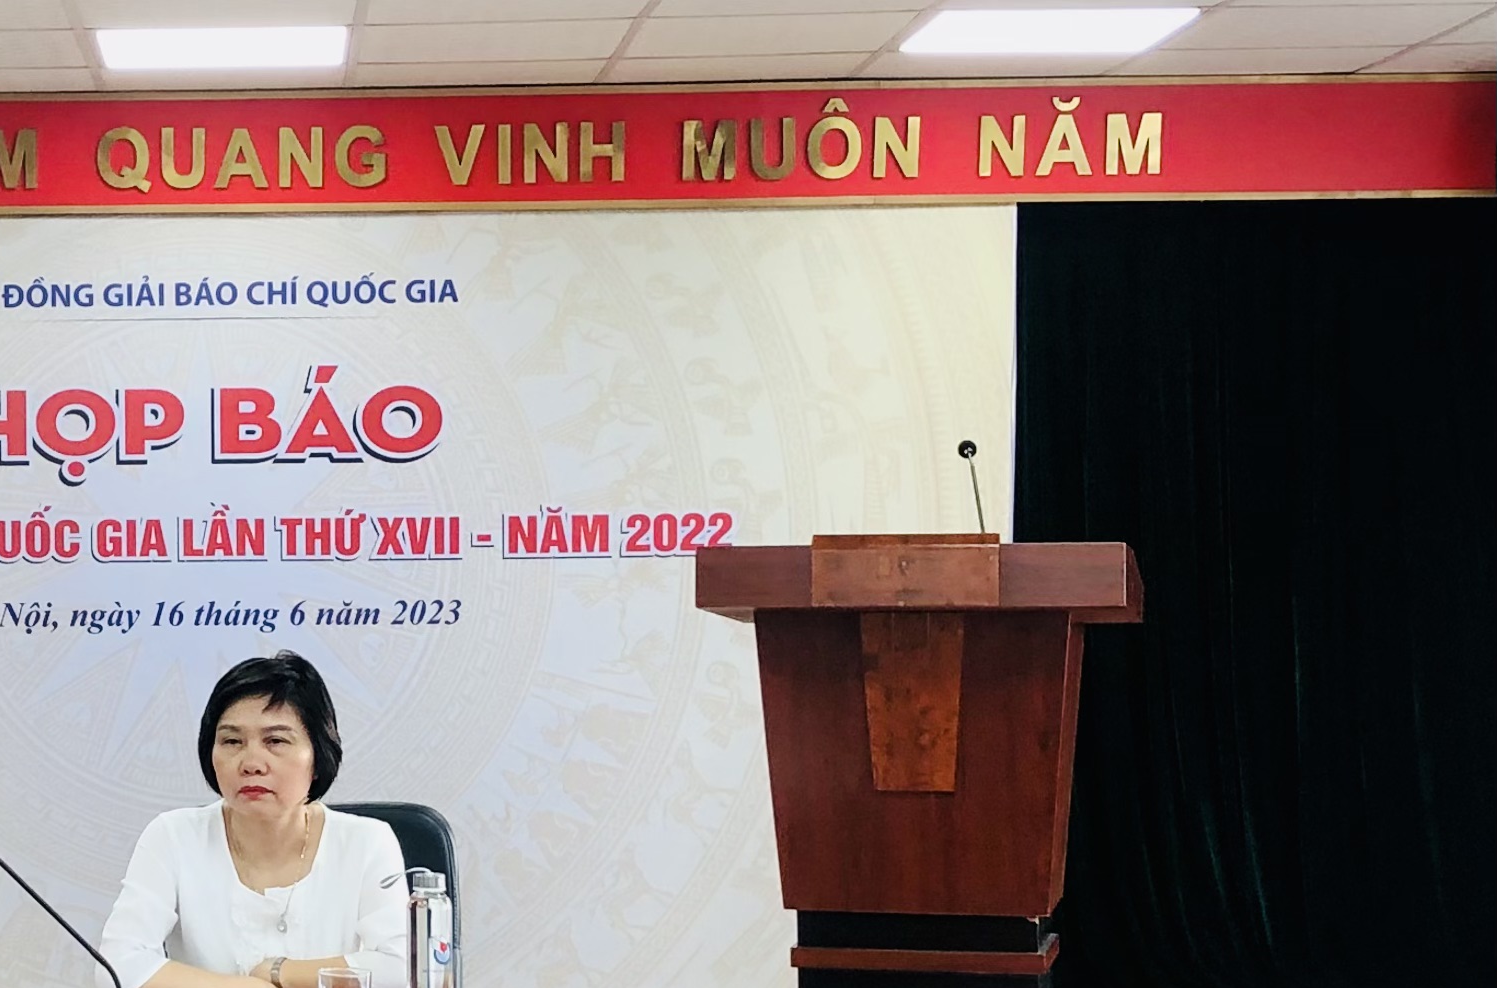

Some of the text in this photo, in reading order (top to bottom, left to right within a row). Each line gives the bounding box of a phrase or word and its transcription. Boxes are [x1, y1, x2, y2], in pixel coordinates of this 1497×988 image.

[96, 125, 388, 195] QUANG
[434, 119, 627, 187] VINH
[681, 97, 922, 183] MUÔN
[978, 96, 1164, 179] NĂM
[1, 276, 94, 308] ĐỒNG
[103, 275, 164, 307] GIẢI
[174, 277, 238, 307] BÁO
[246, 275, 299, 305] CHÍ
[306, 272, 397, 307] QUỐC
[405, 279, 459, 304] GIA
[213, 364, 444, 463] BÁO
[92, 517, 170, 562] GIA
[179, 503, 266, 561] LẦN
[276, 508, 367, 560] THỨ
[372, 514, 461, 558] XVII
[504, 505, 610, 557] NĂM
[623, 511, 733, 553] 2022
[69, 601, 141, 634] ngày
[152, 601, 185, 627] 16
[194, 600, 279, 634] tháng
[290, 600, 306, 626] 6
[315, 599, 380, 626] năm
[391, 599, 462, 626] 2023
